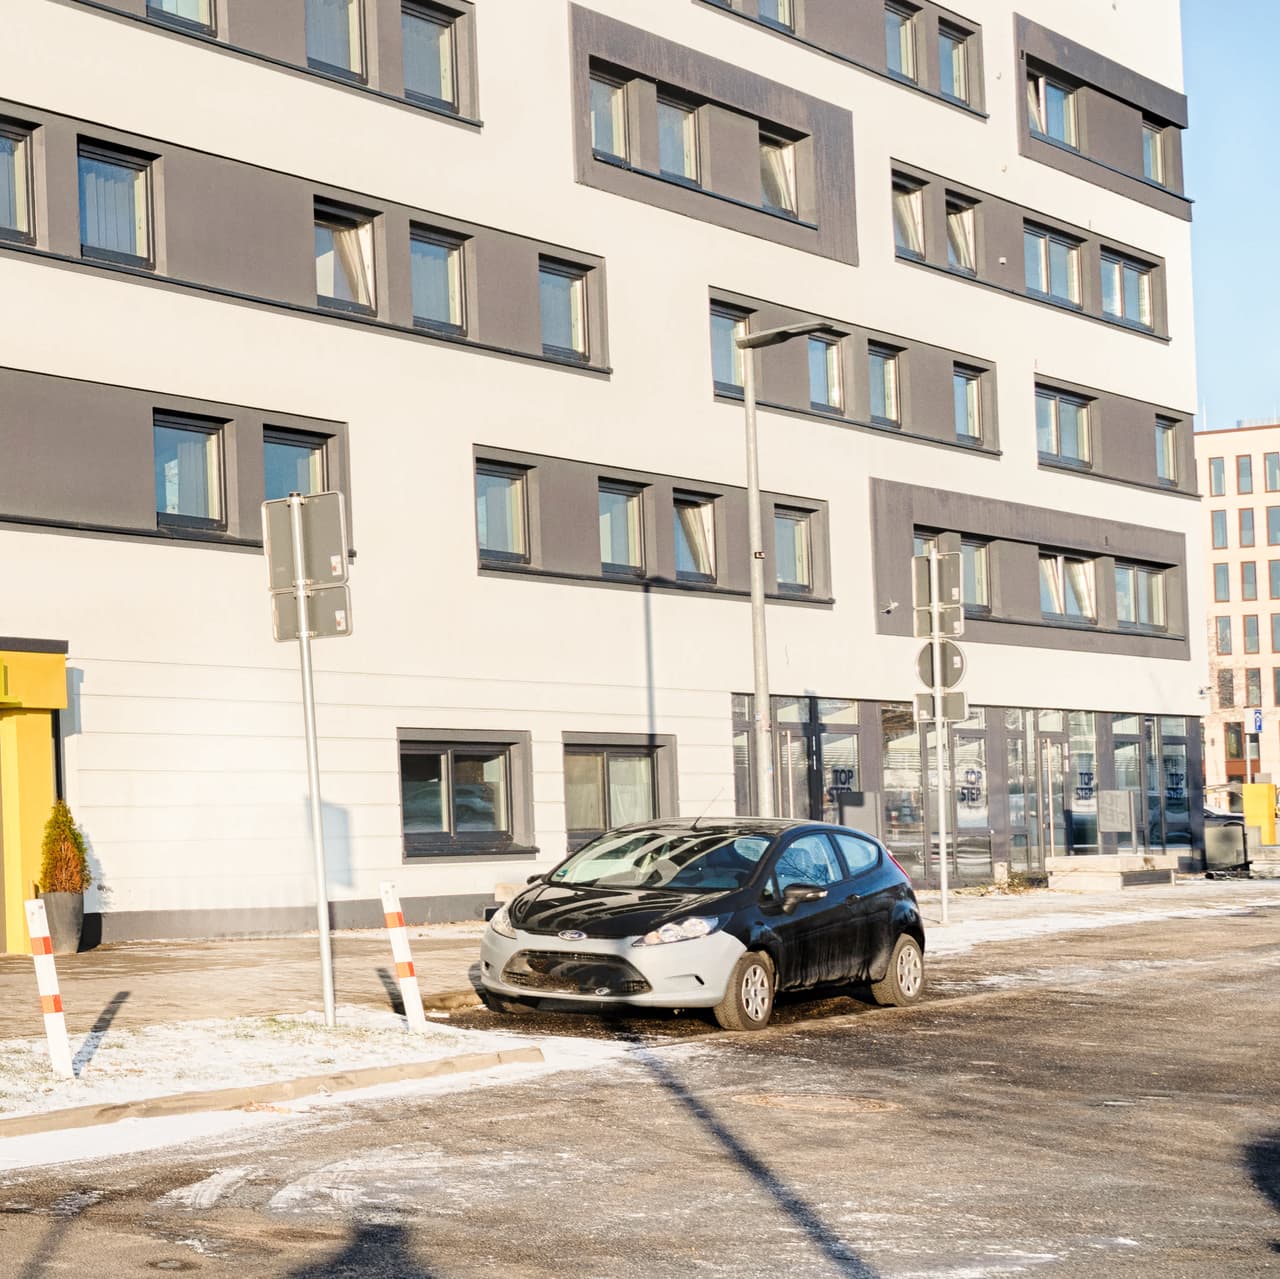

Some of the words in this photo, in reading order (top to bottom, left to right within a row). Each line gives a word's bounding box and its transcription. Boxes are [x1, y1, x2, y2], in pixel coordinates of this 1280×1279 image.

[832, 769, 854, 785] TOP
[965, 769, 983, 785] TOP
[1078, 772, 1094, 786] TOP
[961, 786, 982, 802] STEP
[1075, 787, 1094, 801] STEP
